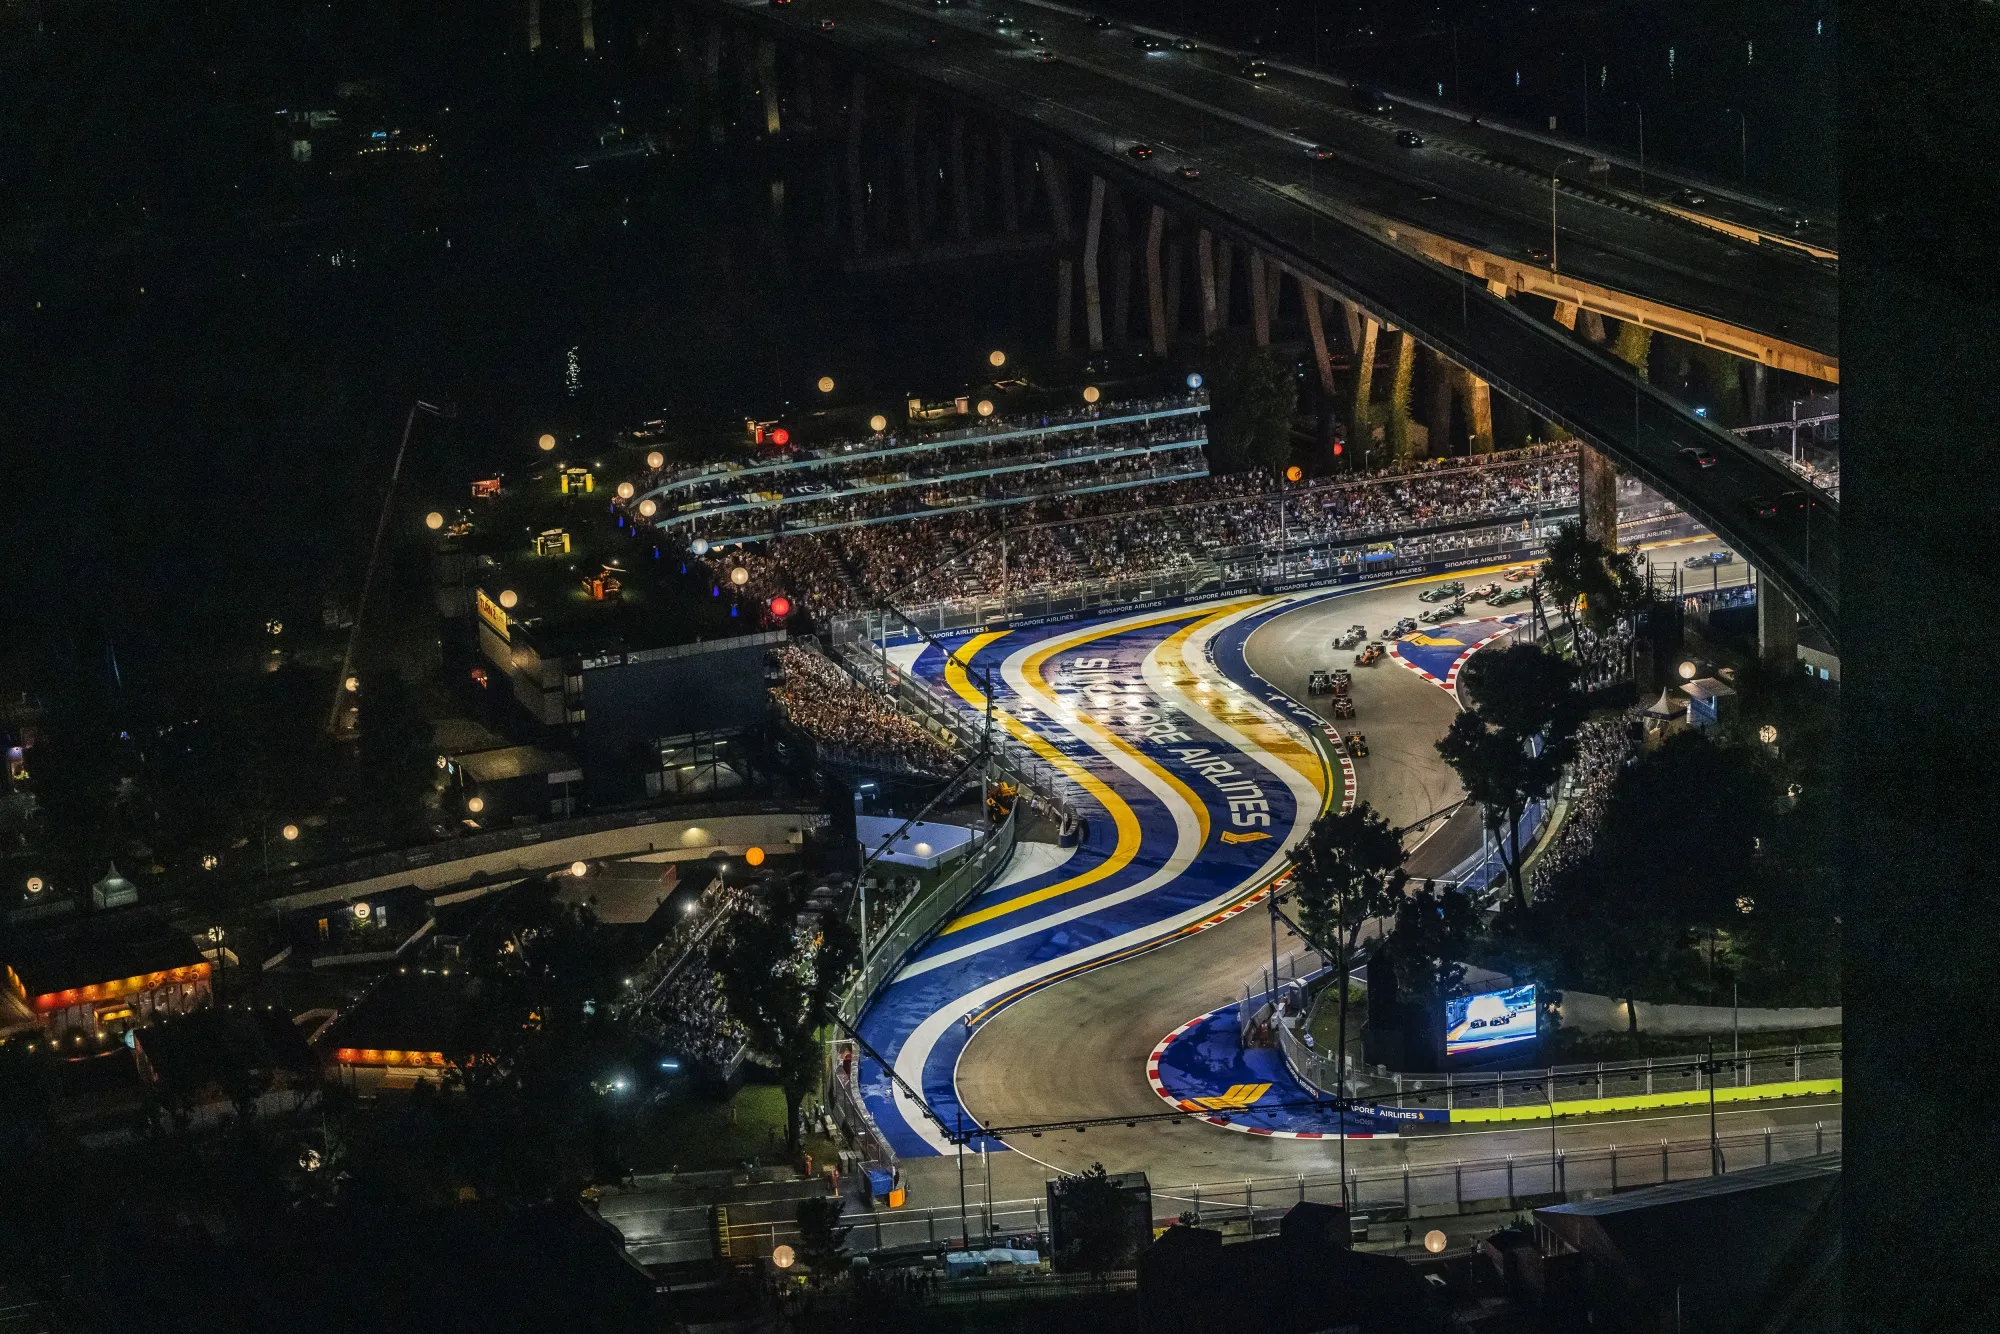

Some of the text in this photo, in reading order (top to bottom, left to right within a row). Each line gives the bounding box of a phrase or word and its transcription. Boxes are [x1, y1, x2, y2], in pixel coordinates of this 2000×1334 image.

[1617, 533, 1645, 542] INGAPORE
[1445, 554, 1507, 568] SINGAPORE AIRLINES
[1359, 566, 1422, 581] SINGAPORE AIRLINES
[1273, 578, 1337, 592] SINGAPORE AIRLINES
[1184, 588, 1248, 603] SINGAPORE AIRLINES
[1098, 600, 1162, 616] SINGAPORE AIRLINES
[1009, 614, 1074, 628] SINGAPORE AIRLINES
[917, 626, 985, 642] SIAPORE AIRLINES
[1168, 748, 1271, 827] AIRLINES
[1379, 1109, 1418, 1119] AIRLINES
